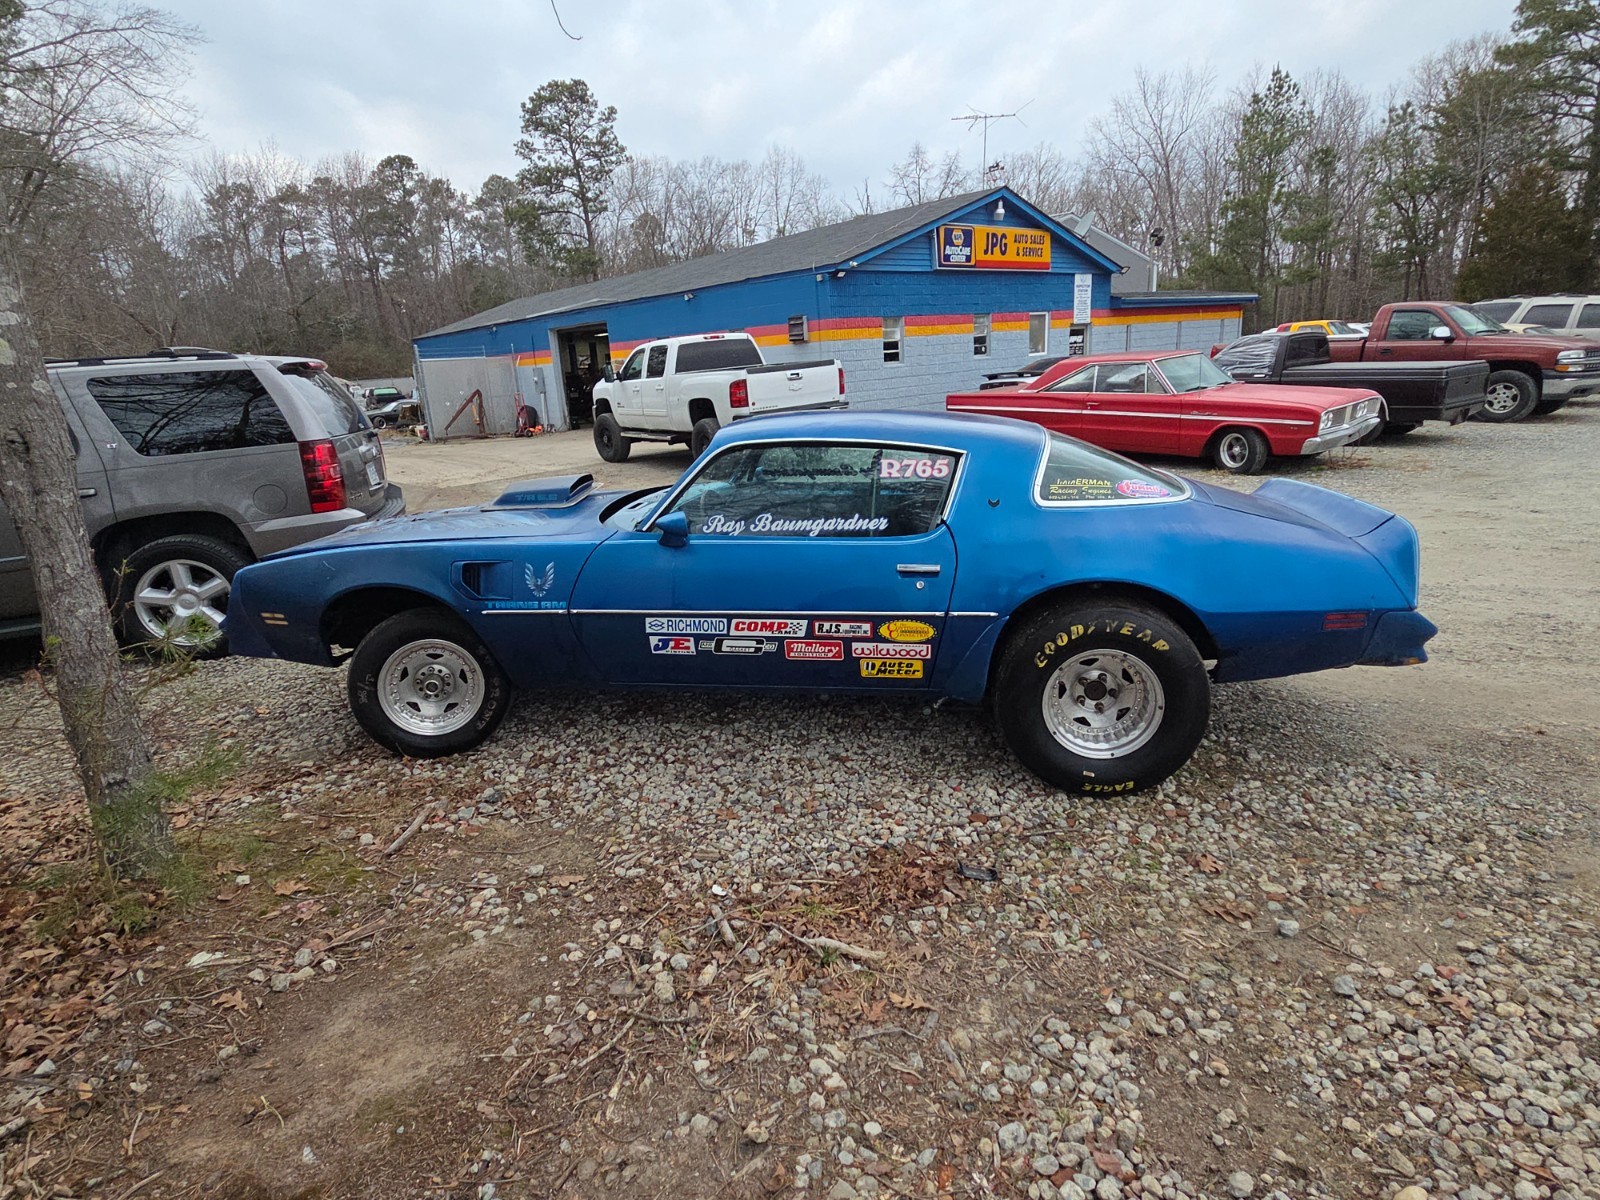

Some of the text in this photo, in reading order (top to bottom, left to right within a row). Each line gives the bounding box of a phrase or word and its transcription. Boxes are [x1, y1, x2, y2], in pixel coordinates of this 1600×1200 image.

[983, 232, 1008, 256] JPG
[1014, 233, 1045, 245] AUTO SALES
[1016, 247, 1043, 258] & SERVICE
[879, 459, 949, 478] R765
[1050, 486, 1078, 495] Racing
[703, 513, 889, 537] Ray Baumgardner
[486, 601, 567, 609] TRANS AM
[666, 619, 726, 633] RICHMOND
[734, 621, 789, 632] COMP
[653, 638, 691, 652] JE
[791, 643, 839, 655] Mallory
[853, 644, 929, 657] wilwood
[879, 661, 914, 669] Auto
